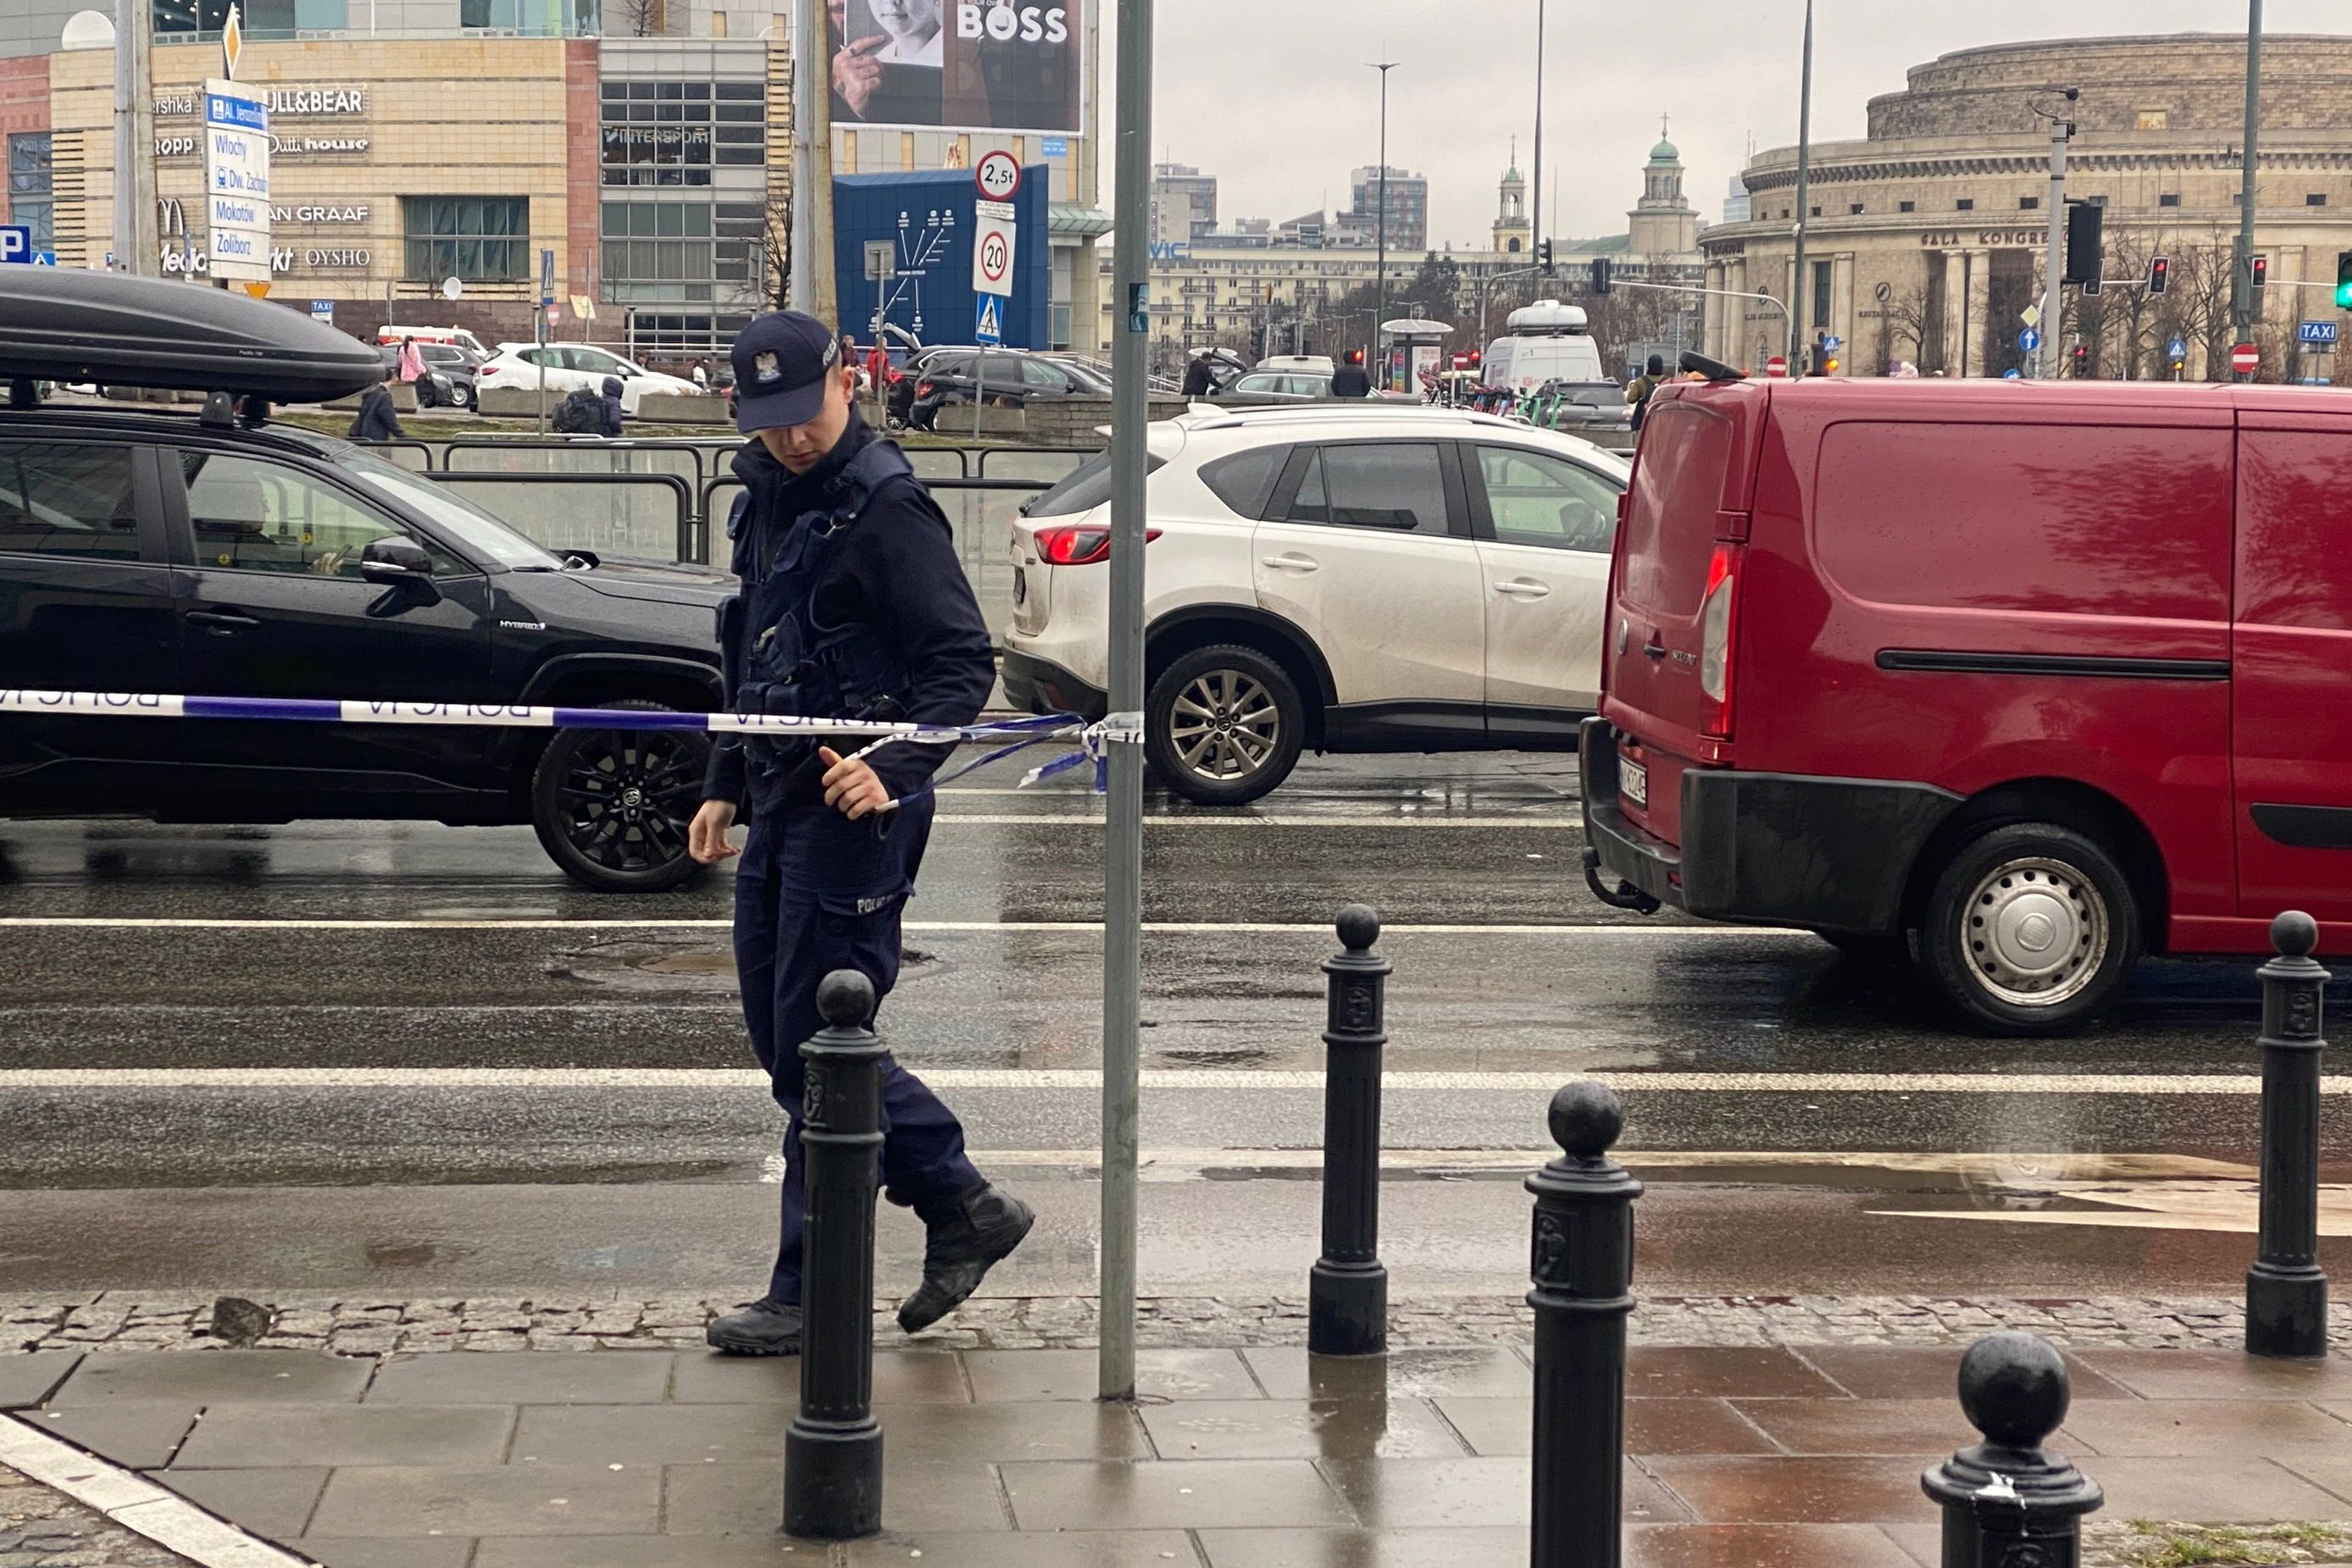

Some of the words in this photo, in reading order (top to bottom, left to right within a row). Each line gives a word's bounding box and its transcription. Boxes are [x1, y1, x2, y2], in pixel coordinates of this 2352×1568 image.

[957, 4, 1068, 42] BOSS
[305, 138, 369, 150] house
[619, 130, 709, 143] INTERSPORT
[214, 135, 247, 162] Włochy
[216, 201, 254, 222] Mokotów
[297, 207, 369, 220] GRAAF
[217, 229, 251, 255] Żoliborz
[305, 249, 370, 265] OYSHO
[986, 245, 1004, 269] 20
[312, 301, 331, 311] TAXI
[2303, 324, 2335, 339] TAXI
